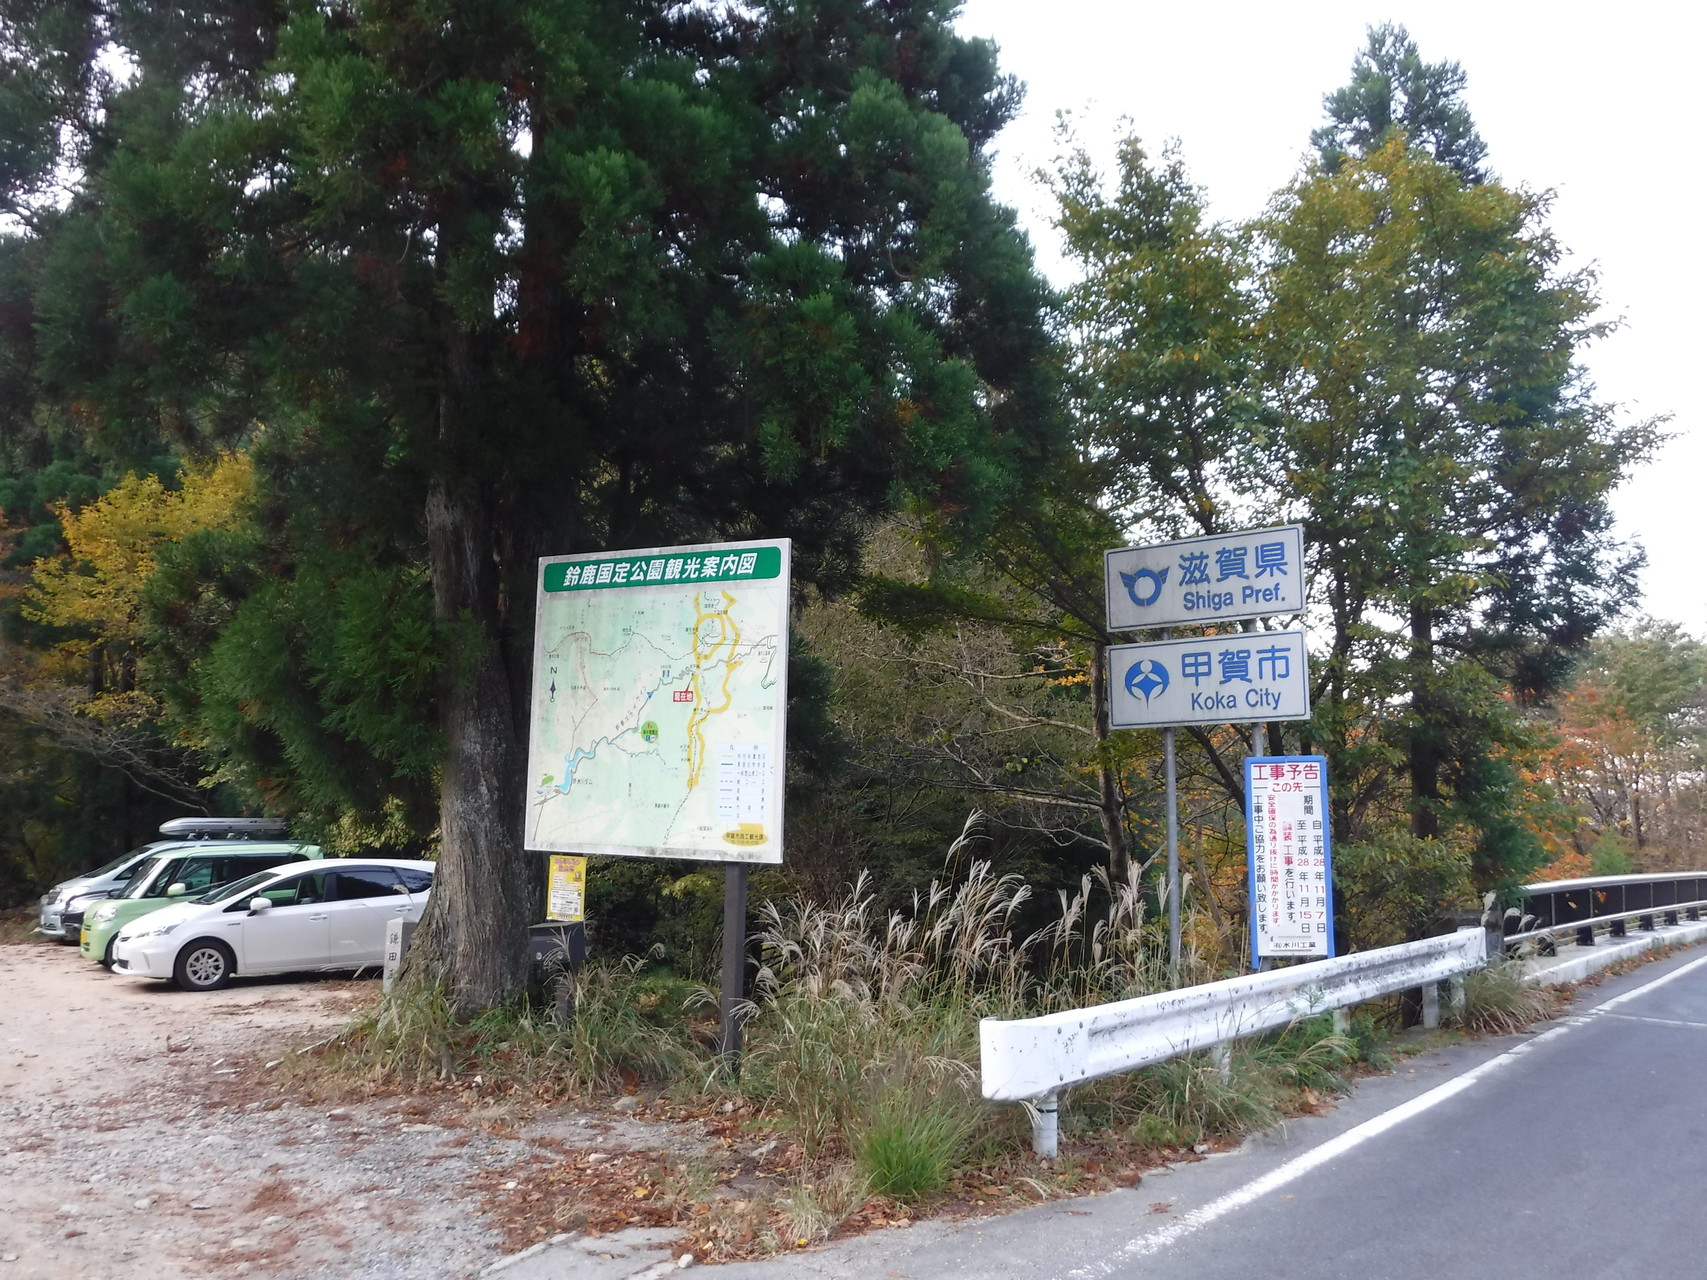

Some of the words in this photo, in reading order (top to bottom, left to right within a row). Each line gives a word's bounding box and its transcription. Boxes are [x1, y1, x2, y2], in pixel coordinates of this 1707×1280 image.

[563, 552, 758, 587] 鈴鹿国定公園観光案内図
[1179, 542, 1288, 586] 滋賀県
[1183, 590, 1234, 611] Shiga
[1242, 582, 1286, 604] Pref.
[550, 666, 558, 674] N
[1181, 645, 1291, 687] 甲賀市
[1191, 690, 1237, 711] Koka
[1245, 688, 1281, 710] City
[1252, 764, 1319, 781] 工事予告
[1272, 781, 1303, 793] この先
[1303, 795, 1314, 815] 期間
[1253, 795, 1268, 935] 工事中ご協力をお願い致します。
